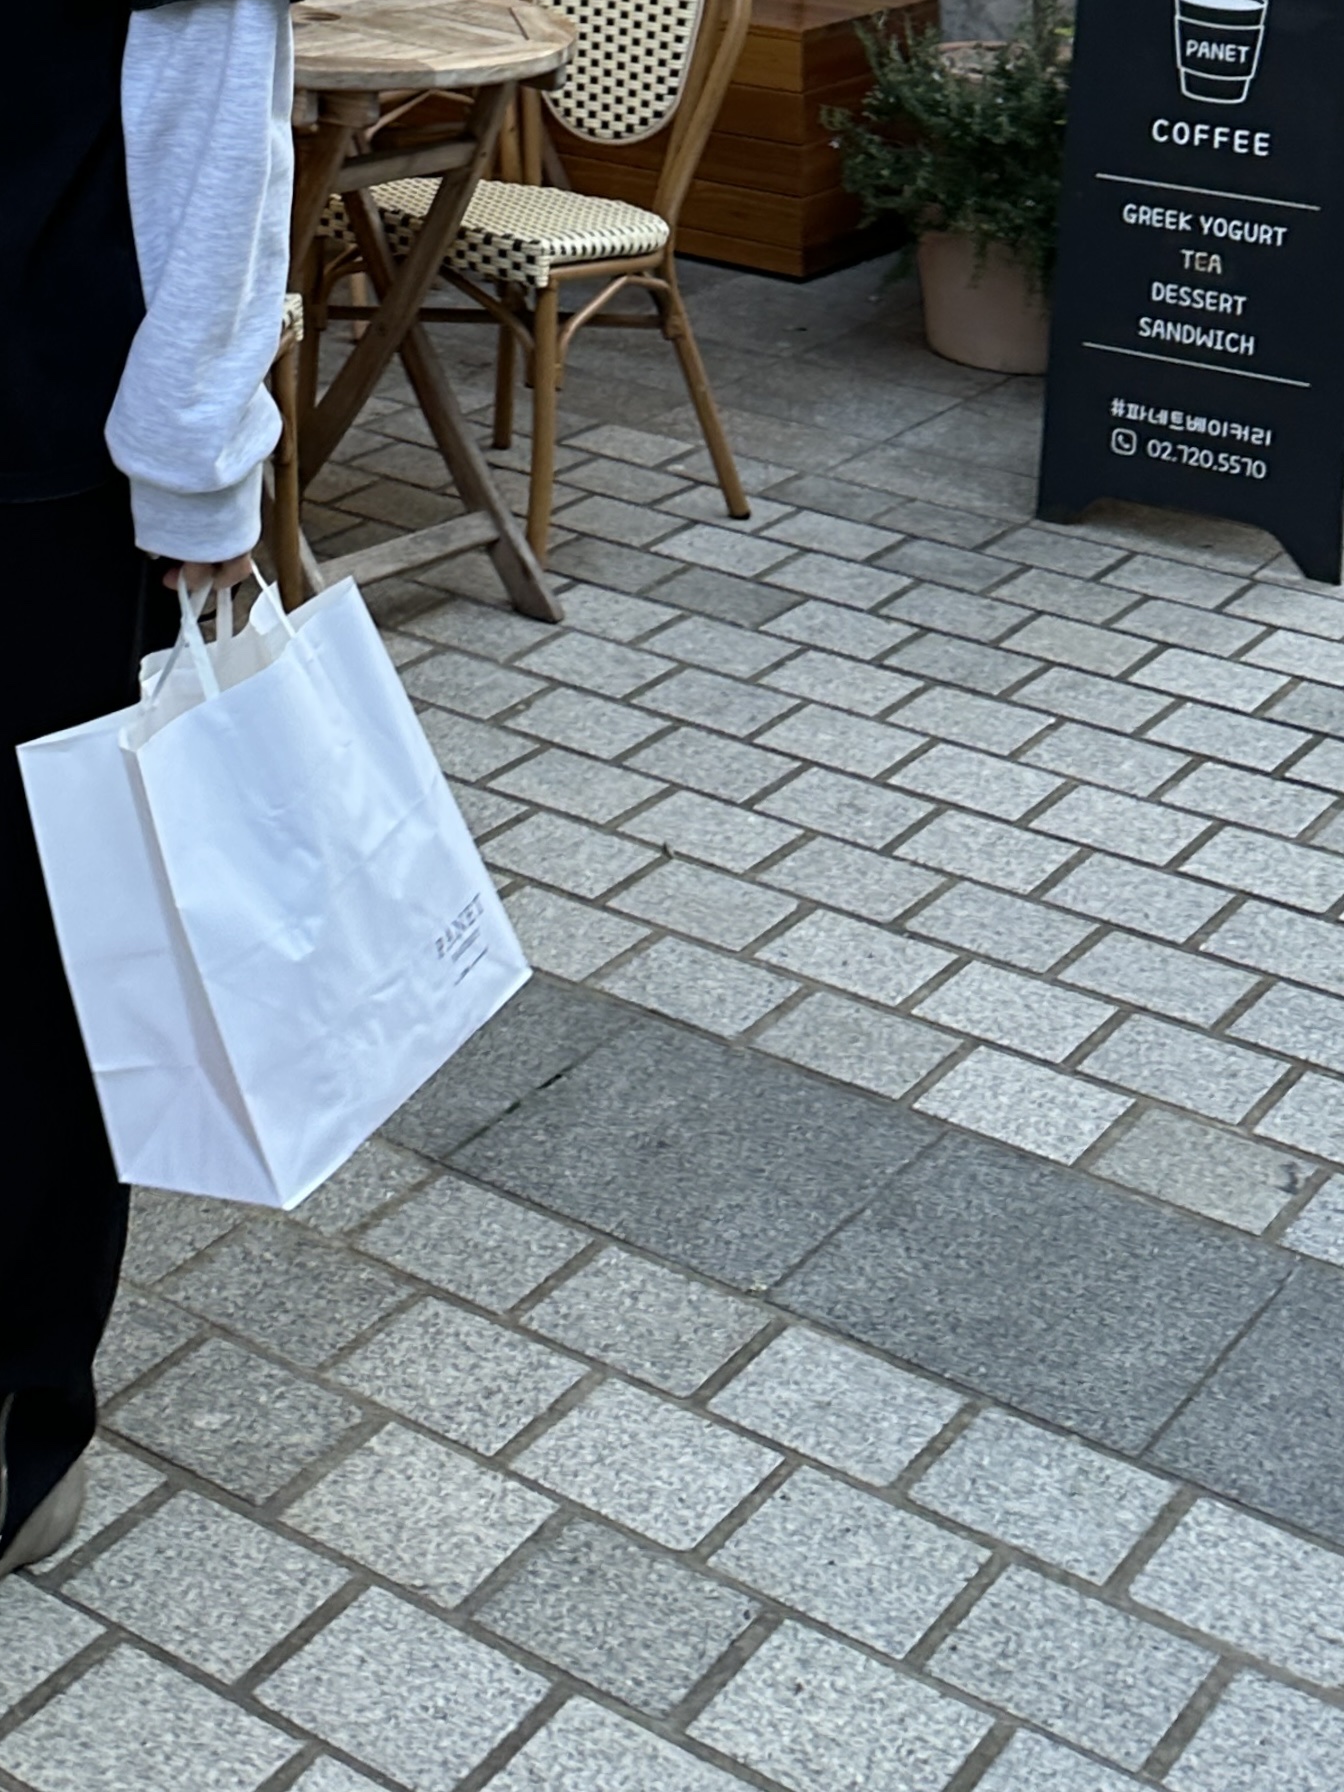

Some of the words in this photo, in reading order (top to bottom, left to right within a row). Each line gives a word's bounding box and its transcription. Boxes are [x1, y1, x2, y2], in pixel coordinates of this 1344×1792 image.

[1185, 39, 1251, 64] PANET
[1151, 118, 1272, 157] COFFEE
[1122, 203, 1194, 231] GREEK
[1199, 215, 1288, 247] YOGURT
[1180, 249, 1223, 275] TEA
[1151, 281, 1247, 316] DESSERT
[1138, 316, 1256, 356] SANDWICH
[1110, 397, 1273, 447] #파네트베이커리
[1146, 439, 1267, 480] 02.720.5570
